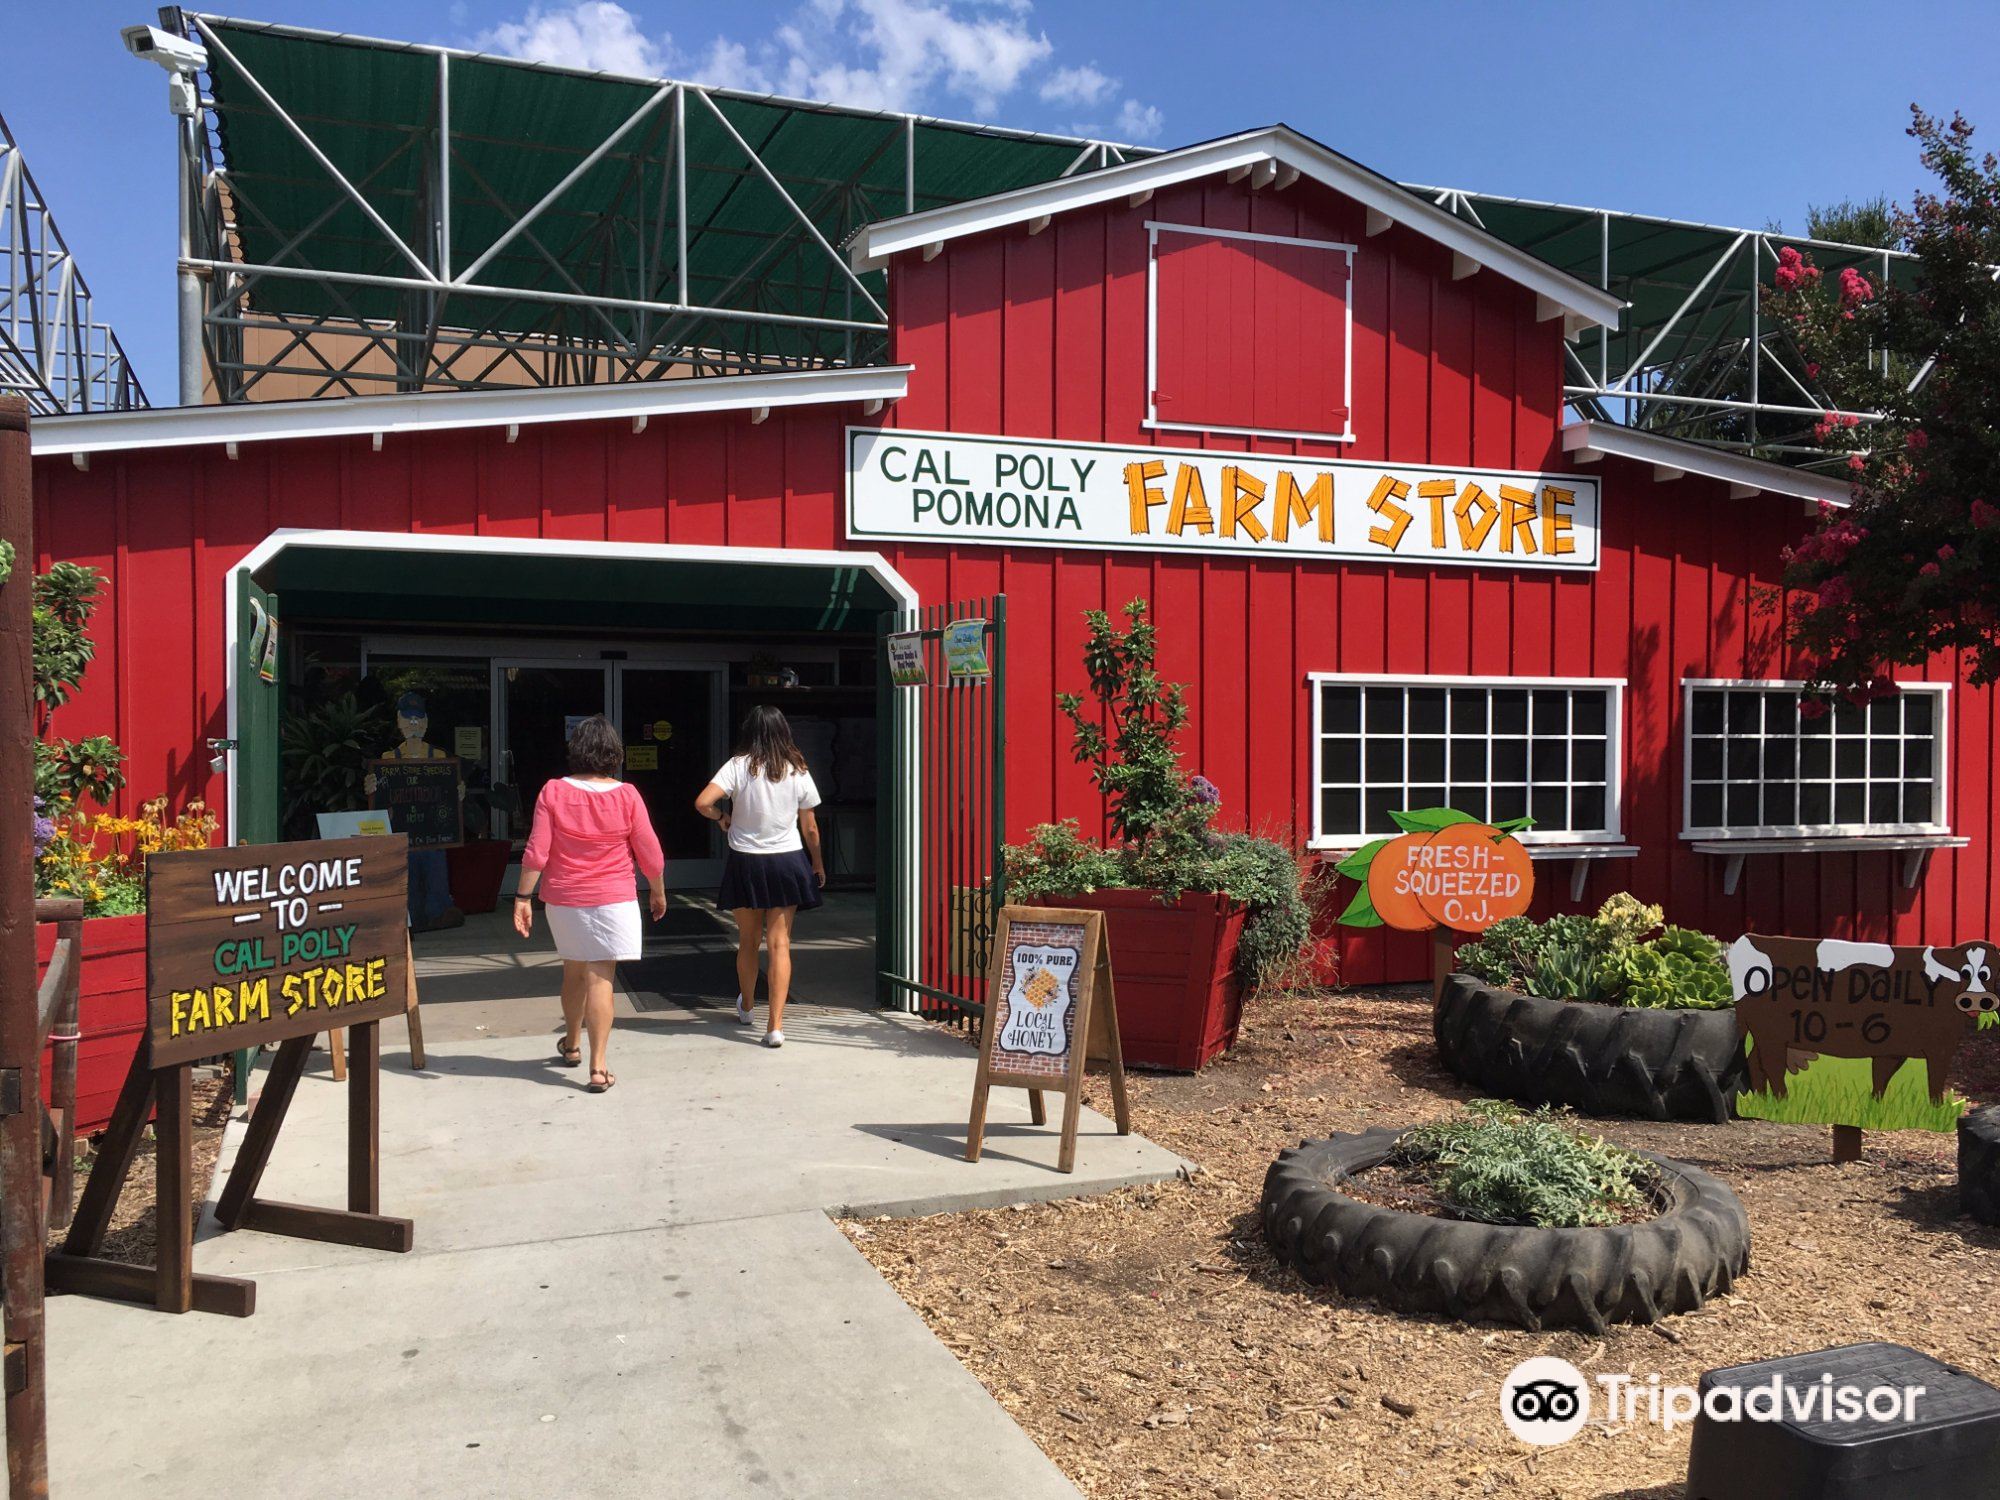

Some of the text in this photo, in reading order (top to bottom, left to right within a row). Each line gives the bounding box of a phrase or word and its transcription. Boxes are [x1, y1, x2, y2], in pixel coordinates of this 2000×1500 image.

[879, 446, 1096, 493] CAL POLY
[912, 488, 1082, 530] POMONA
[1122, 459, 1577, 555] FARM STORE
[1407, 846, 1504, 869] FRESH-
[213, 858, 362, 903] WELCOME
[1394, 869, 1521, 898] SQUEEZED
[270, 897, 309, 930] TO
[1443, 898, 1494, 923] O.J.
[213, 924, 358, 975] CAL POLY
[1017, 952, 1073, 966] 100% PURE
[170, 958, 387, 1037] FARM STORE
[1016, 1011, 1055, 1031] LOCAL
[1008, 1029, 1056, 1049] HONEY
